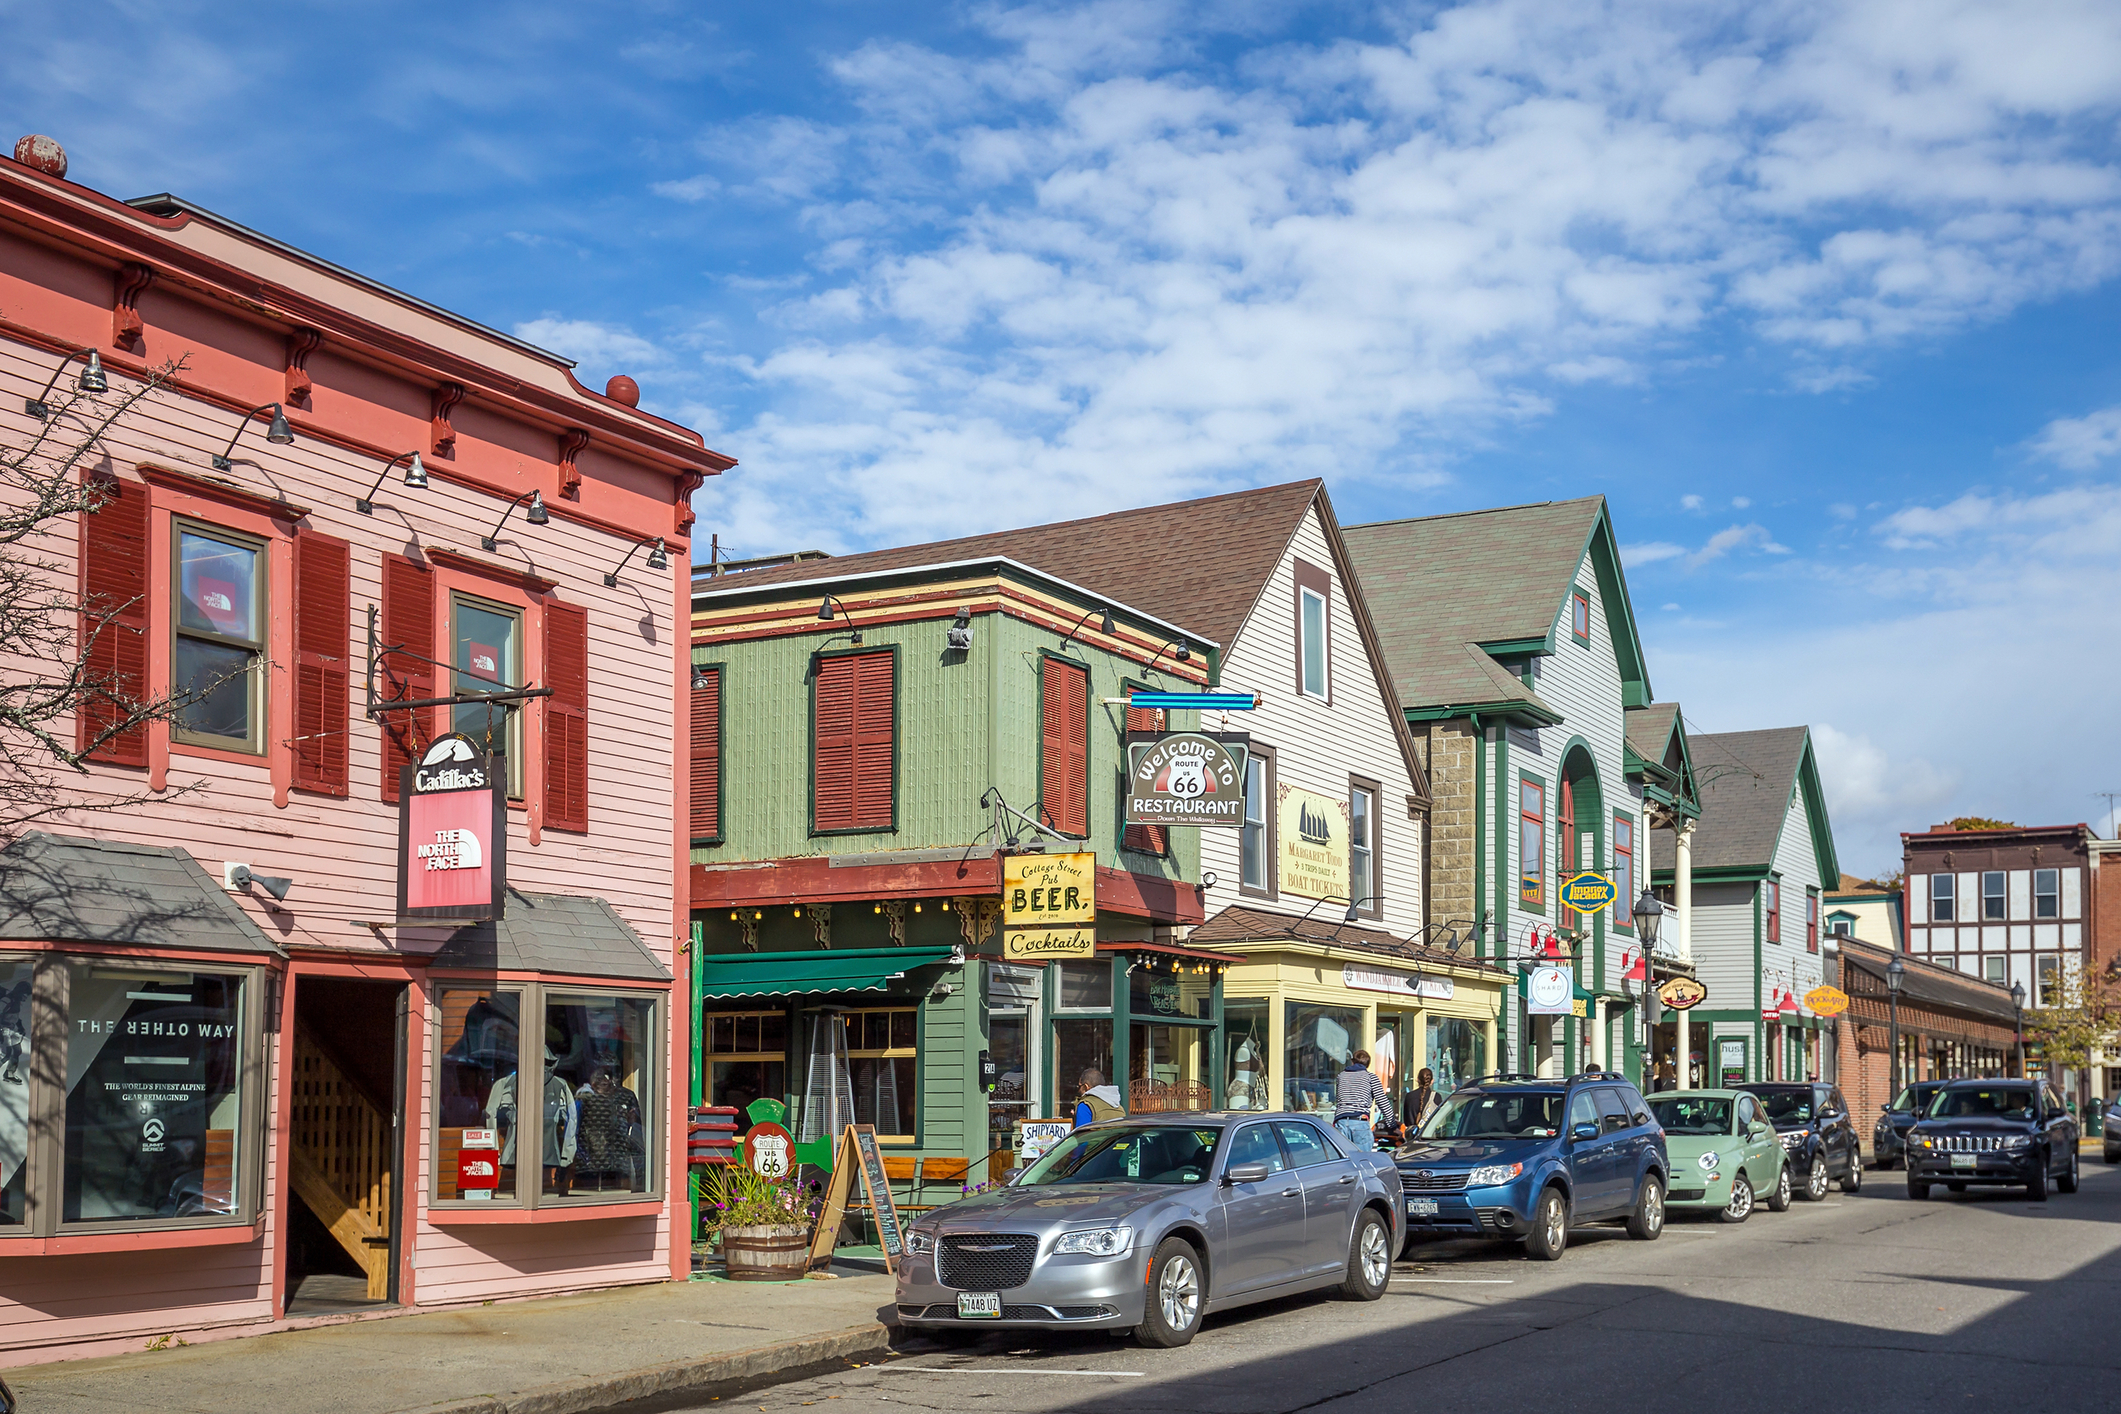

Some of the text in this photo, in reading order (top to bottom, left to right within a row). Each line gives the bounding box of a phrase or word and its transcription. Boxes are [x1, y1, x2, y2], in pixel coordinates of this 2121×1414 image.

[1138, 741, 1234, 786] Welcome To
[416, 768, 484, 792] Cadillac's
[1174, 777, 1198, 793] 66
[1134, 798, 1240, 814] RESTAURANT
[435, 829, 460, 843] THE
[418, 843, 460, 858] NORTH
[1288, 842, 1342, 868] MARGARET TODD
[427, 857, 460, 870] FACE
[1022, 860, 1082, 878] Cottage Street
[1305, 864, 1318, 874] TRIPS
[1040, 874, 1058, 886] Pub
[1288, 873, 1344, 898] BOAT TICKETS
[1010, 931, 1090, 954] Cocktails
[78, 1020, 114, 1034] THE
[198, 1024, 234, 1038] WAY
[104, 1082, 120, 1090] THE
[122, 1083, 154, 1091] WORLD'S
[154, 1083, 180, 1091] FINEST
[1026, 1123, 1066, 1140] SHIPYARD
[763, 1159, 780, 1173] 66
[966, 1299, 997, 1311] 7448 UZ
